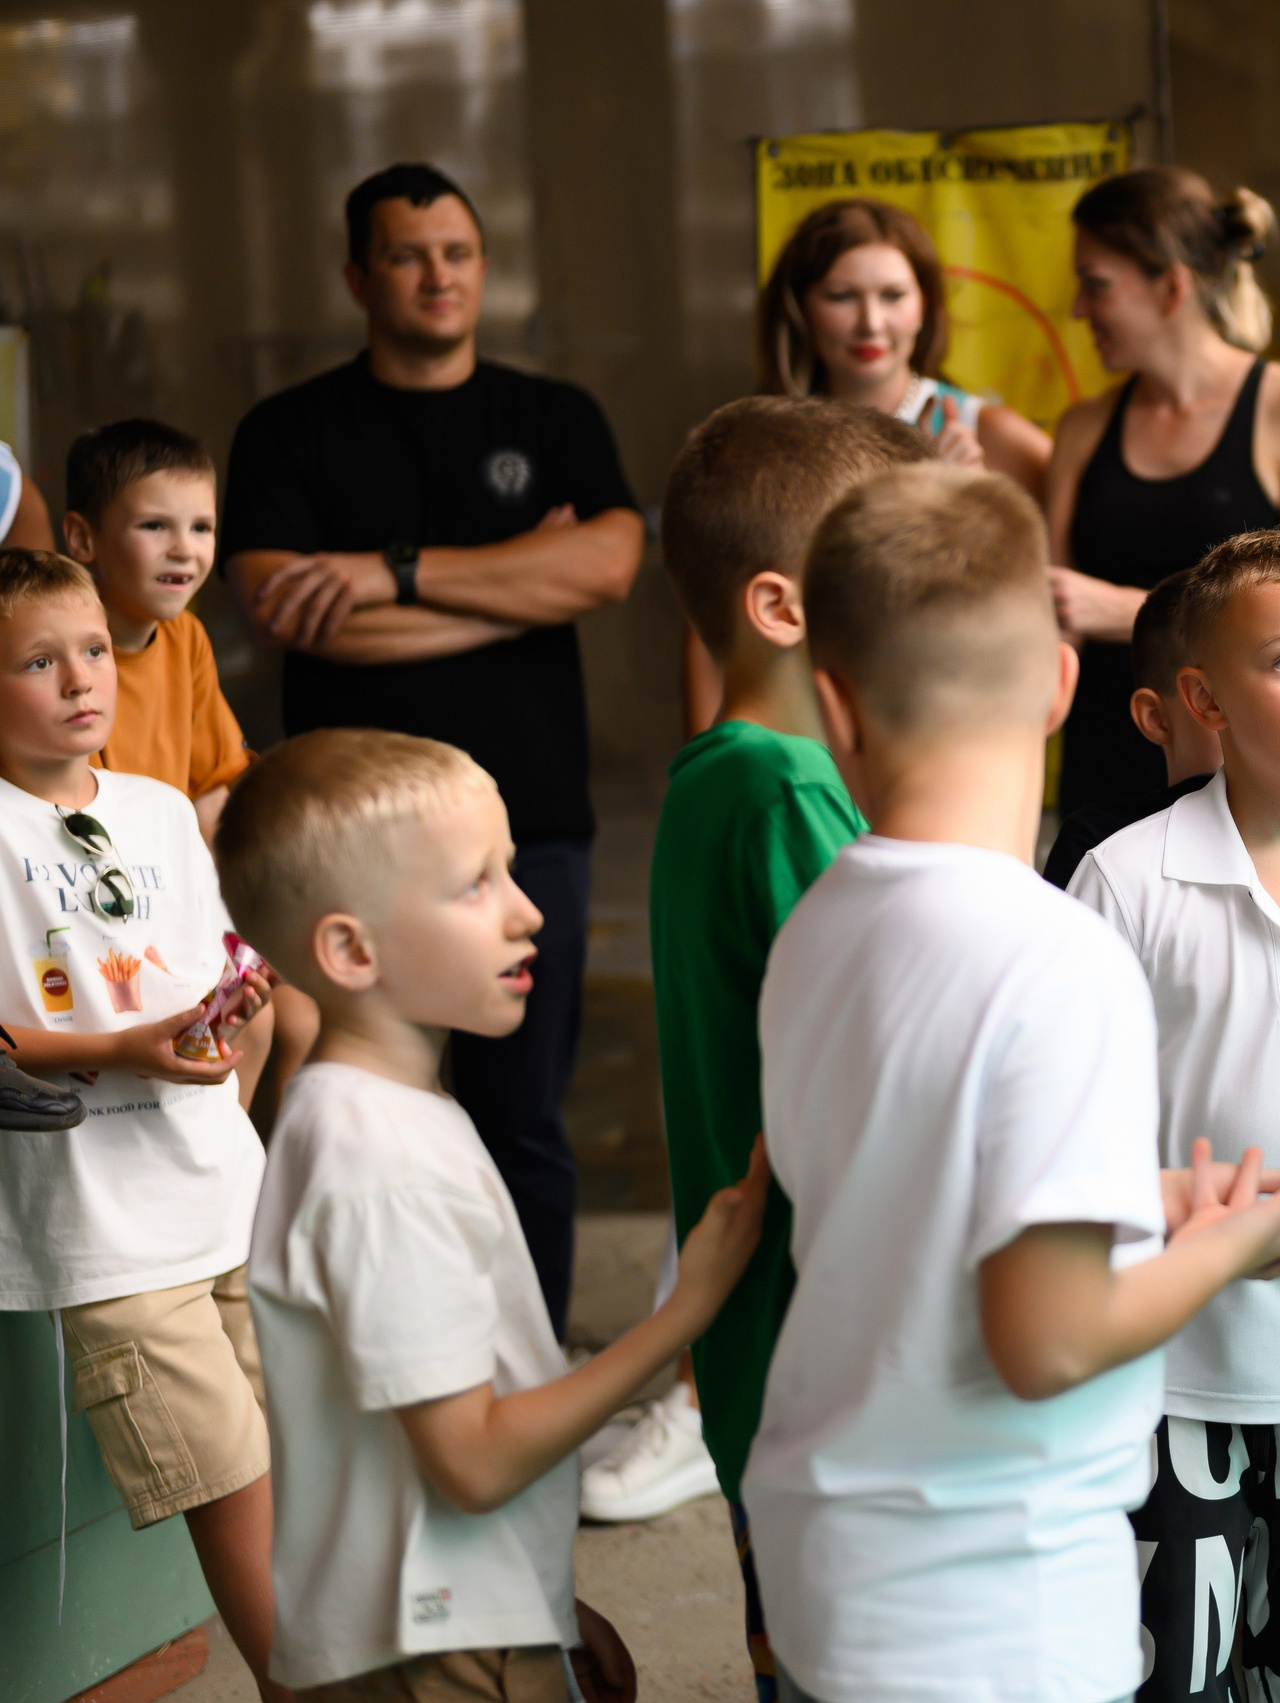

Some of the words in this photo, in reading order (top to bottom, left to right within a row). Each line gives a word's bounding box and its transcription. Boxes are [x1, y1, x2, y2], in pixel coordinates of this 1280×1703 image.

[88, 1106, 104, 1118] NK
[106, 1102, 135, 1115] FOOD
[137, 1100, 160, 1111] FOR
